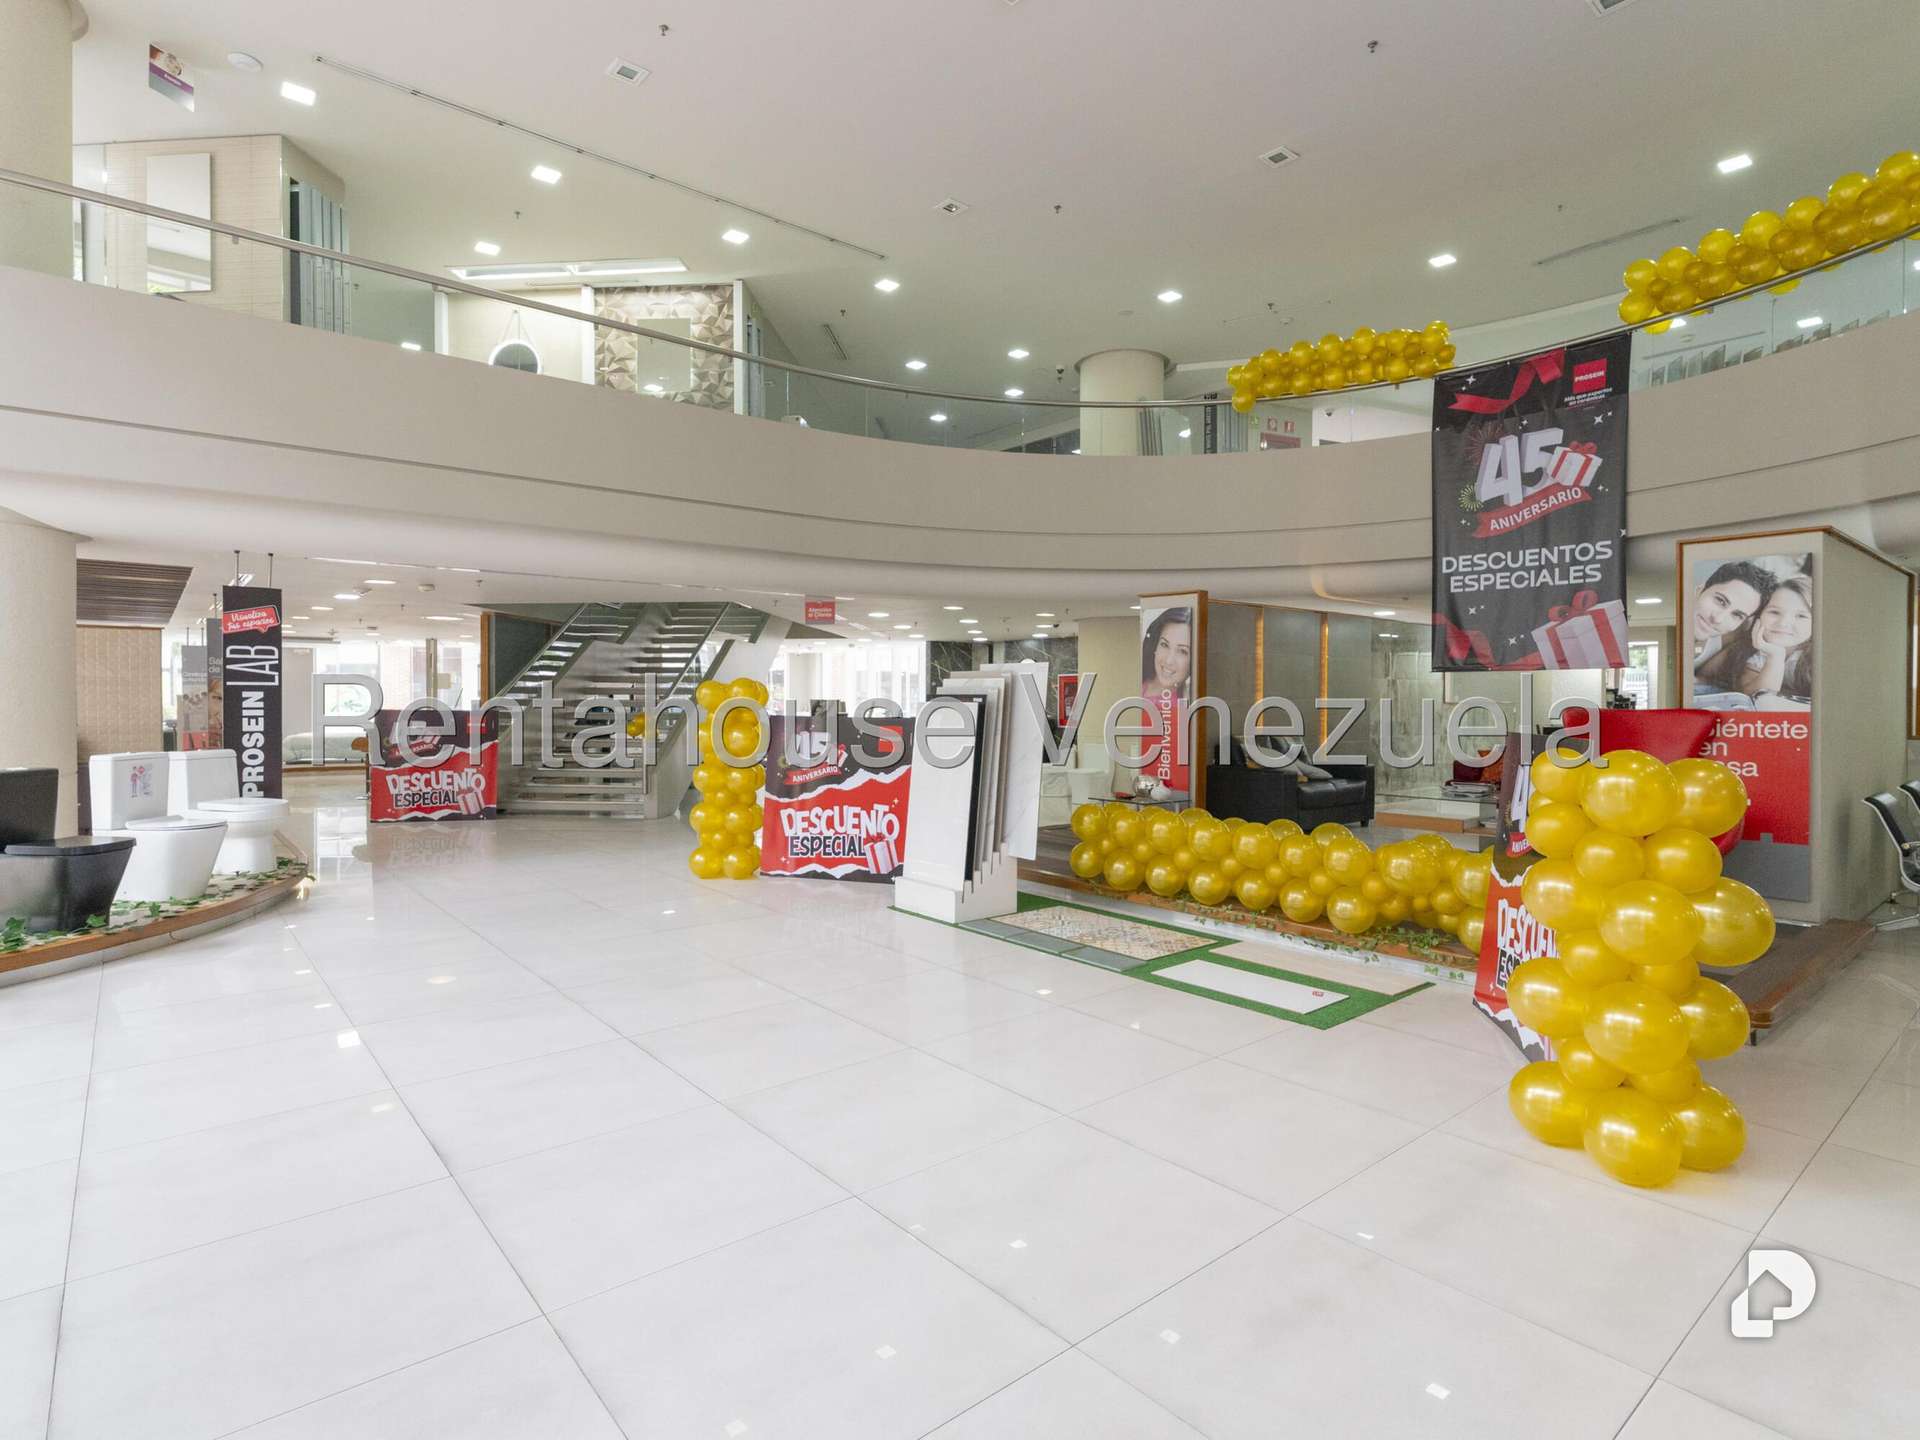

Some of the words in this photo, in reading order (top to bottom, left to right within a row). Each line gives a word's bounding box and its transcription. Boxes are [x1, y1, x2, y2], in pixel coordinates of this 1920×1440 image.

[1574, 370, 1605, 382] PROSEIN
[1475, 428, 1564, 507] 45
[1489, 487, 1582, 531] ANIVERSARIO
[1442, 540, 1613, 574] DESCUENTOS
[1450, 564, 1602, 593] ESPECIALES
[225, 645, 279, 686] LAB
[241, 691, 265, 798] PROSEIN
[1158, 689, 1172, 781] Bienvenido
[386, 768, 486, 795] DESCUENTO
[792, 766, 838, 784] ANIVERSARIO
[1715, 761, 1759, 777] sa
[394, 790, 460, 808] ESPECIAL
[1511, 765, 1535, 832] 4
[780, 804, 900, 841] DESCUENTO
[789, 835, 867, 858] ESPECIAL
[1497, 898, 1560, 962] DESCUEN
